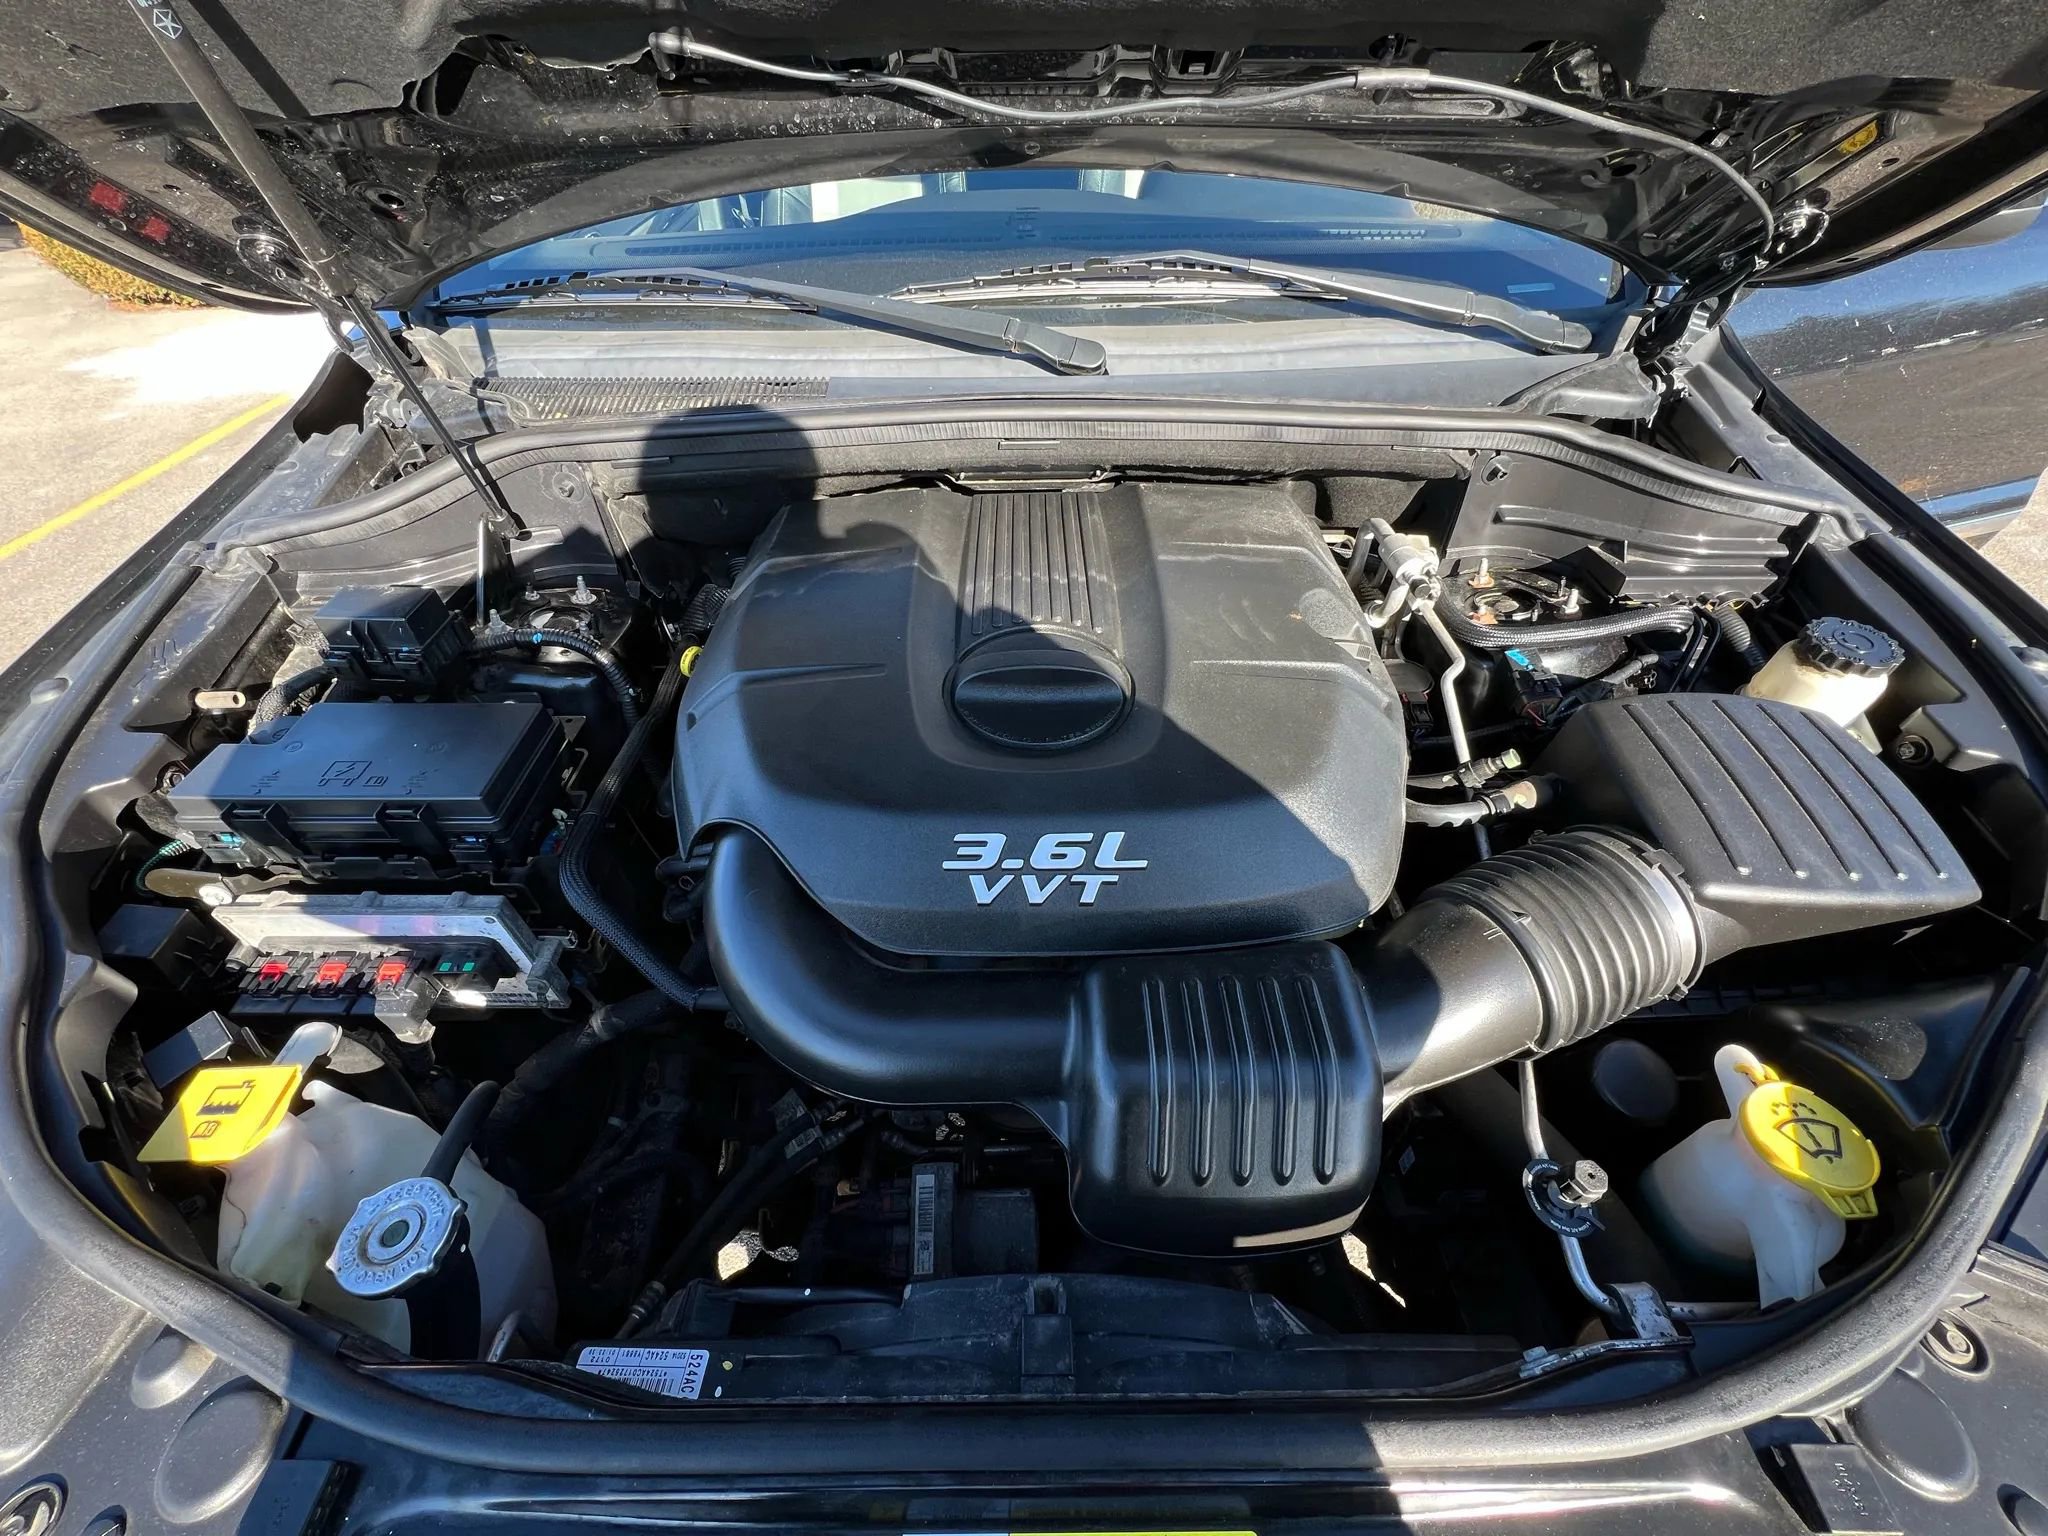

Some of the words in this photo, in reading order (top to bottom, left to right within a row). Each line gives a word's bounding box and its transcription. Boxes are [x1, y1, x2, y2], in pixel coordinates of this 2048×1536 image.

[942, 831, 1149, 870] 3.6L
[968, 874, 1119, 906] VVT
[355, 1268, 396, 1284] OPEN
[400, 1243, 429, 1273] HOT
[645, 1350, 669, 1361] 524AC
[681, 1354, 704, 1394] 524AC
